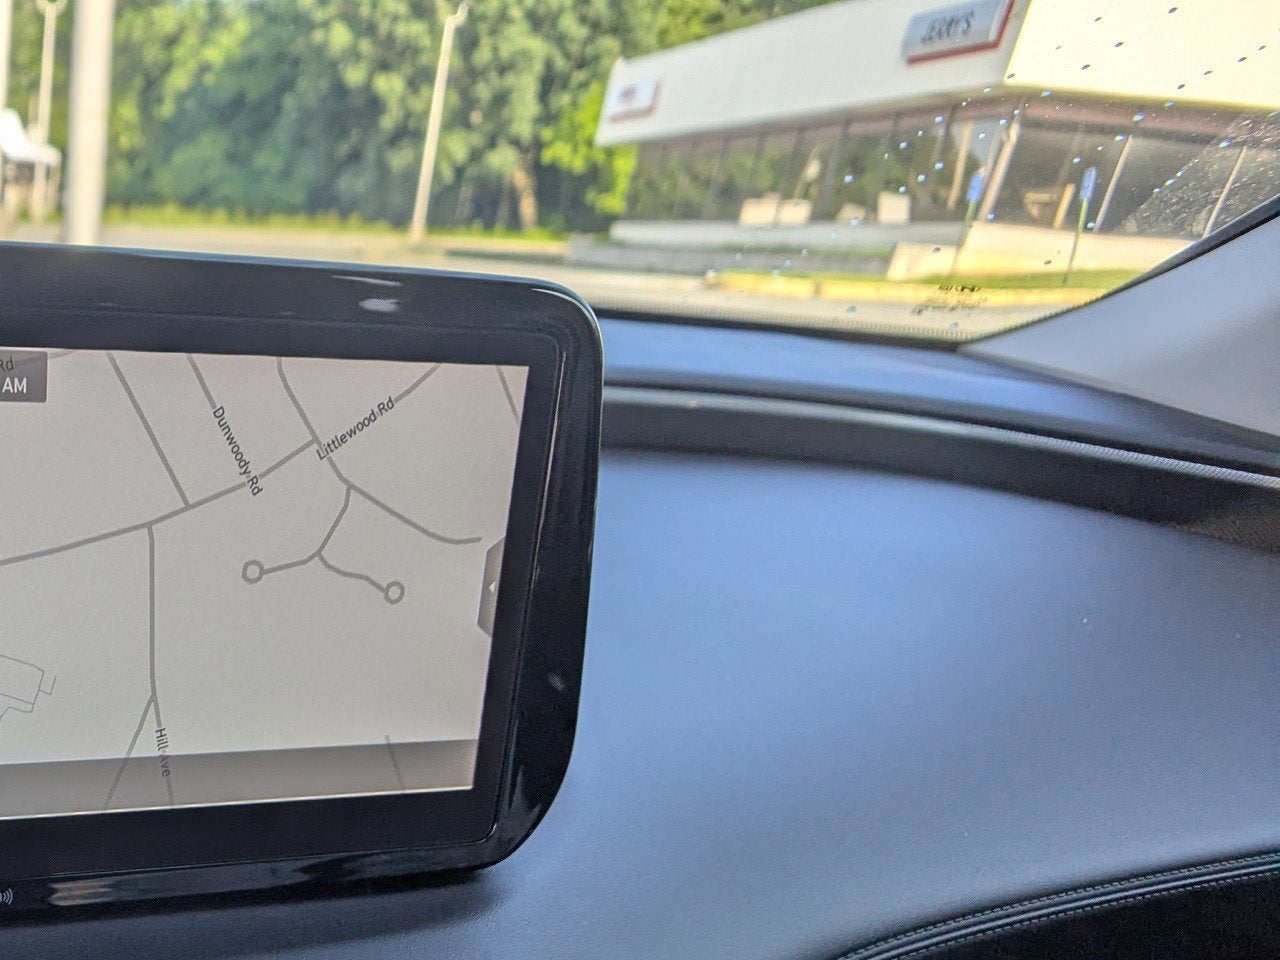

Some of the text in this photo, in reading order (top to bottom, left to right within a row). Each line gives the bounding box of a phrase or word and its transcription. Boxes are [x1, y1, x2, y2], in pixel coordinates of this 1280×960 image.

[1, 377, 28, 394] AM
[212, 406, 264, 497] Dunwoody Rd
[316, 396, 395, 461] Littlewood Rd
